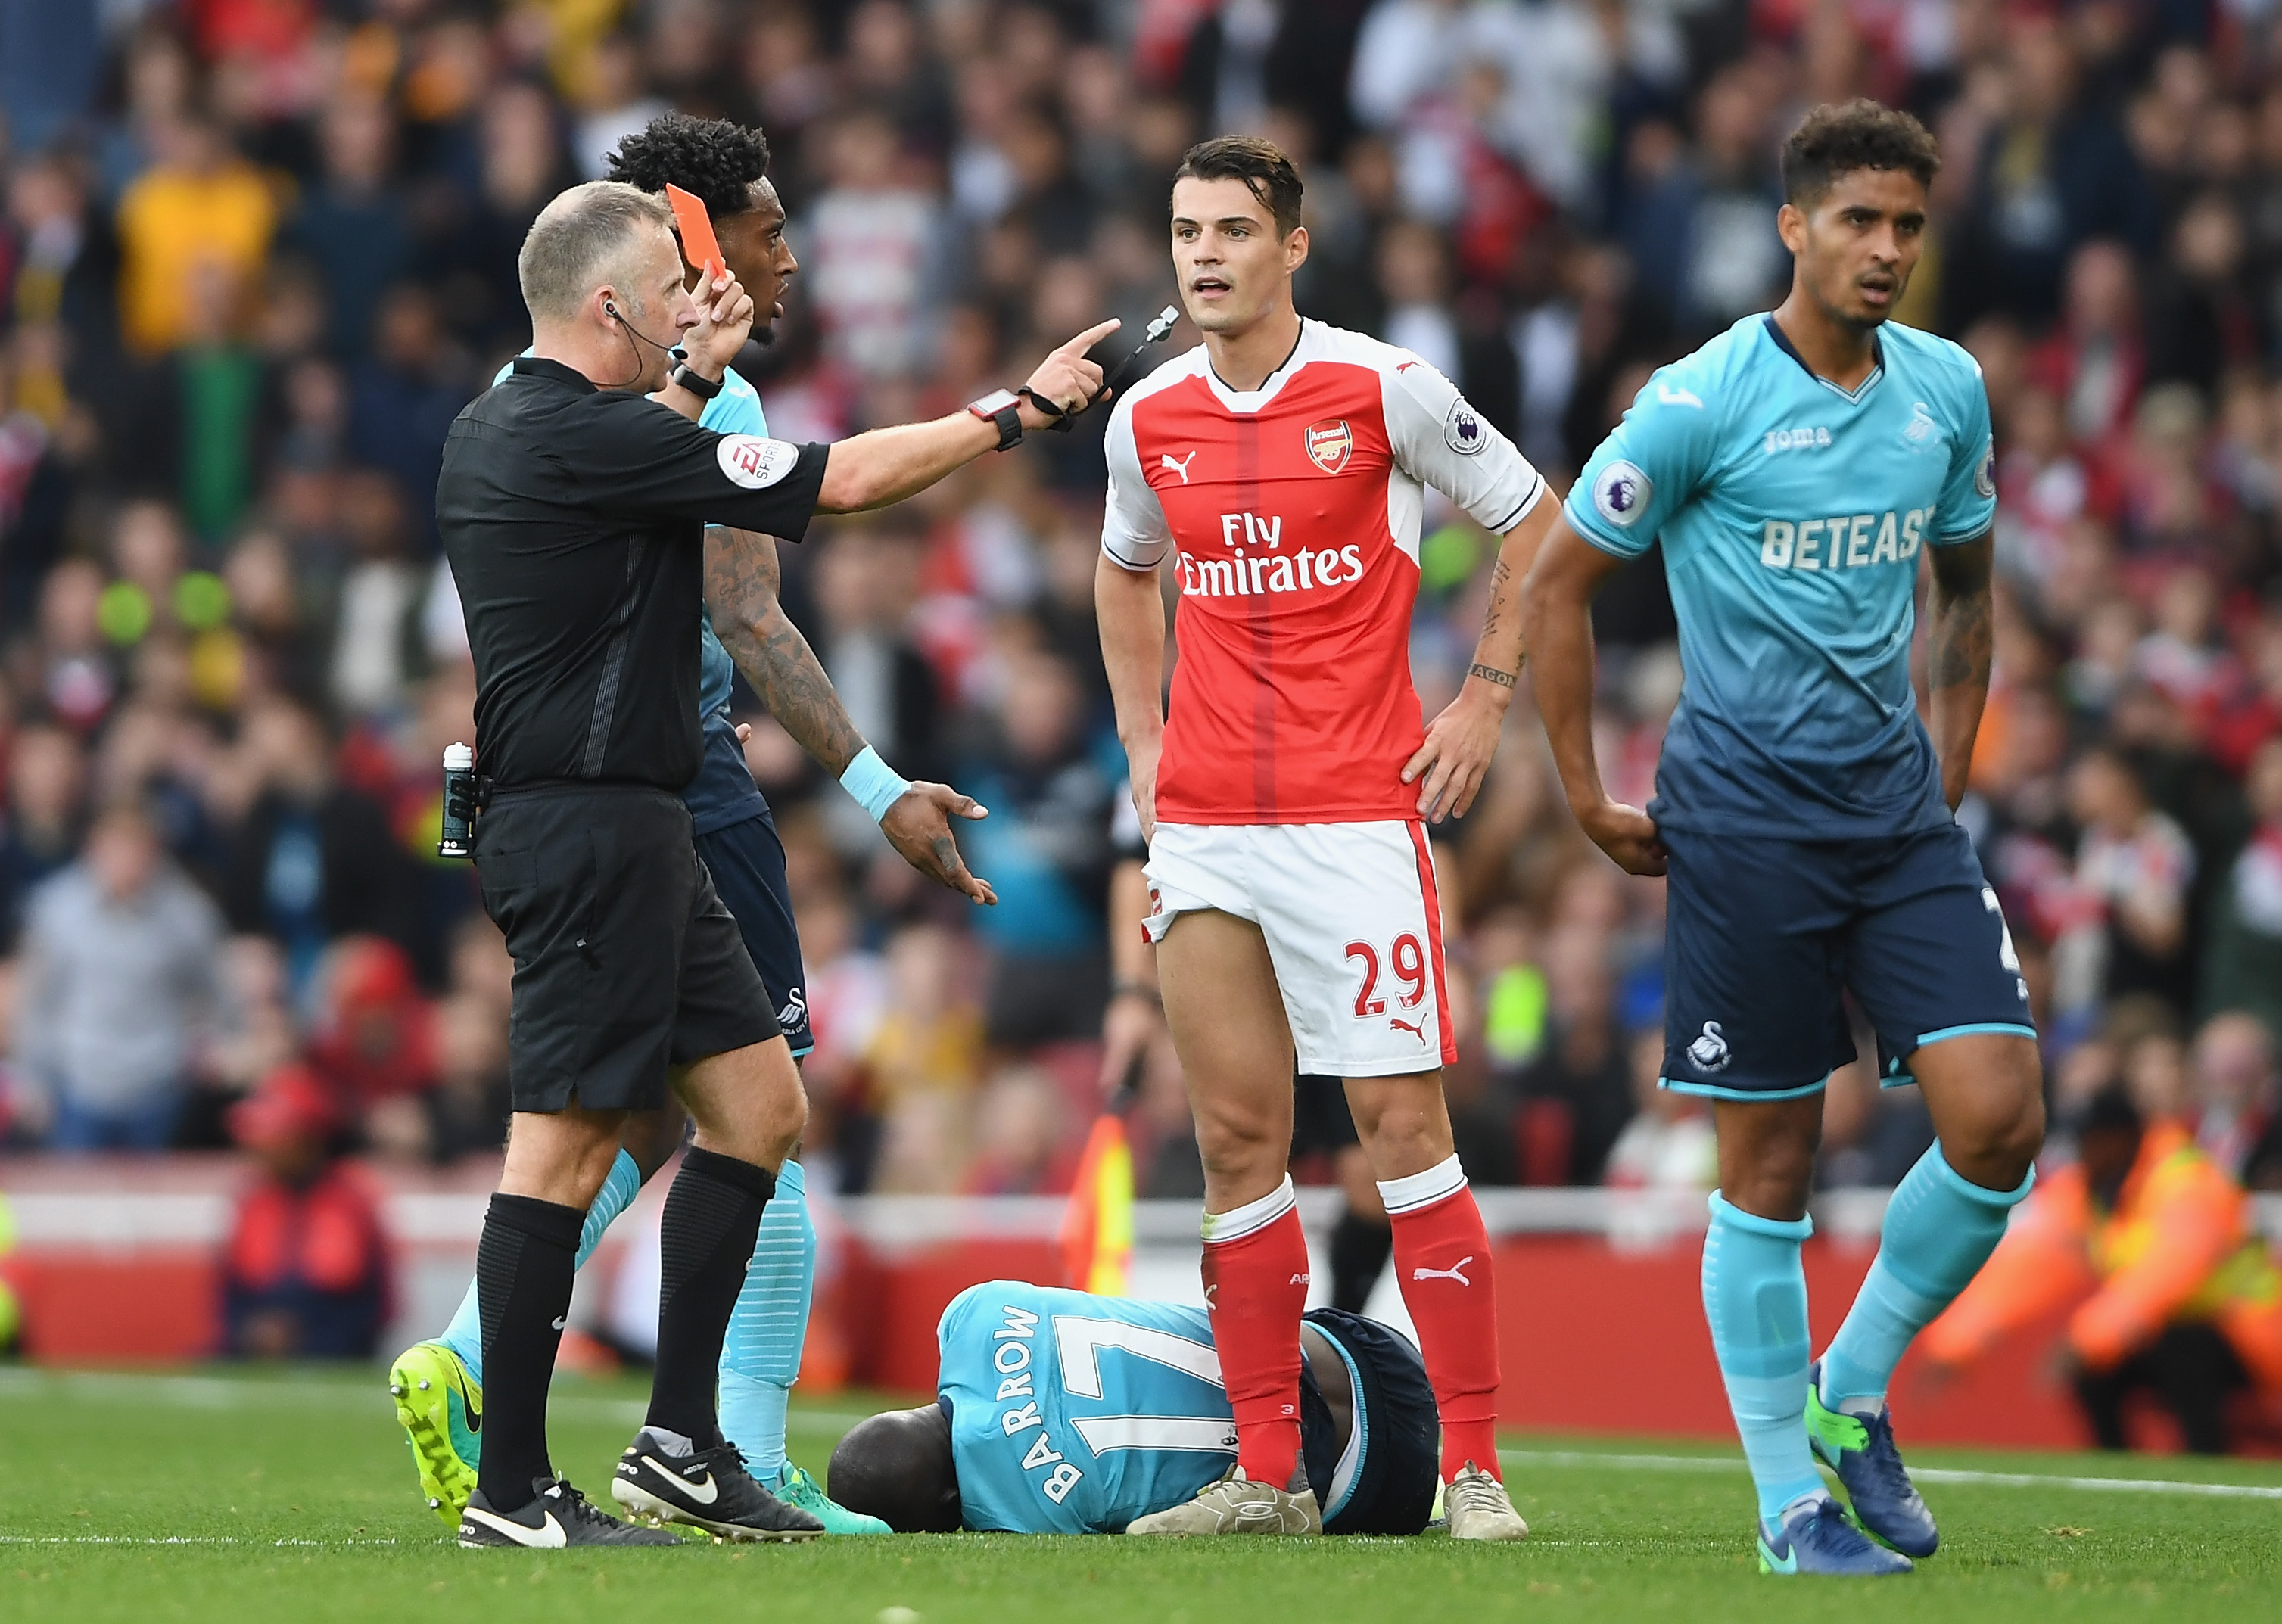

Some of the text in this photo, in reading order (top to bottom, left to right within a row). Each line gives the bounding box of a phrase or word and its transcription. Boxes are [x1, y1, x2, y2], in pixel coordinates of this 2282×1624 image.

[1311, 426, 1345, 441] Arsenal
[1220, 512, 1282, 549] Fly
[1180, 544, 1363, 596] Emirates
[1342, 930, 1428, 1019] 29
[993, 1305, 1085, 1505] BARROW
[1051, 1314, 1240, 1460] 17
